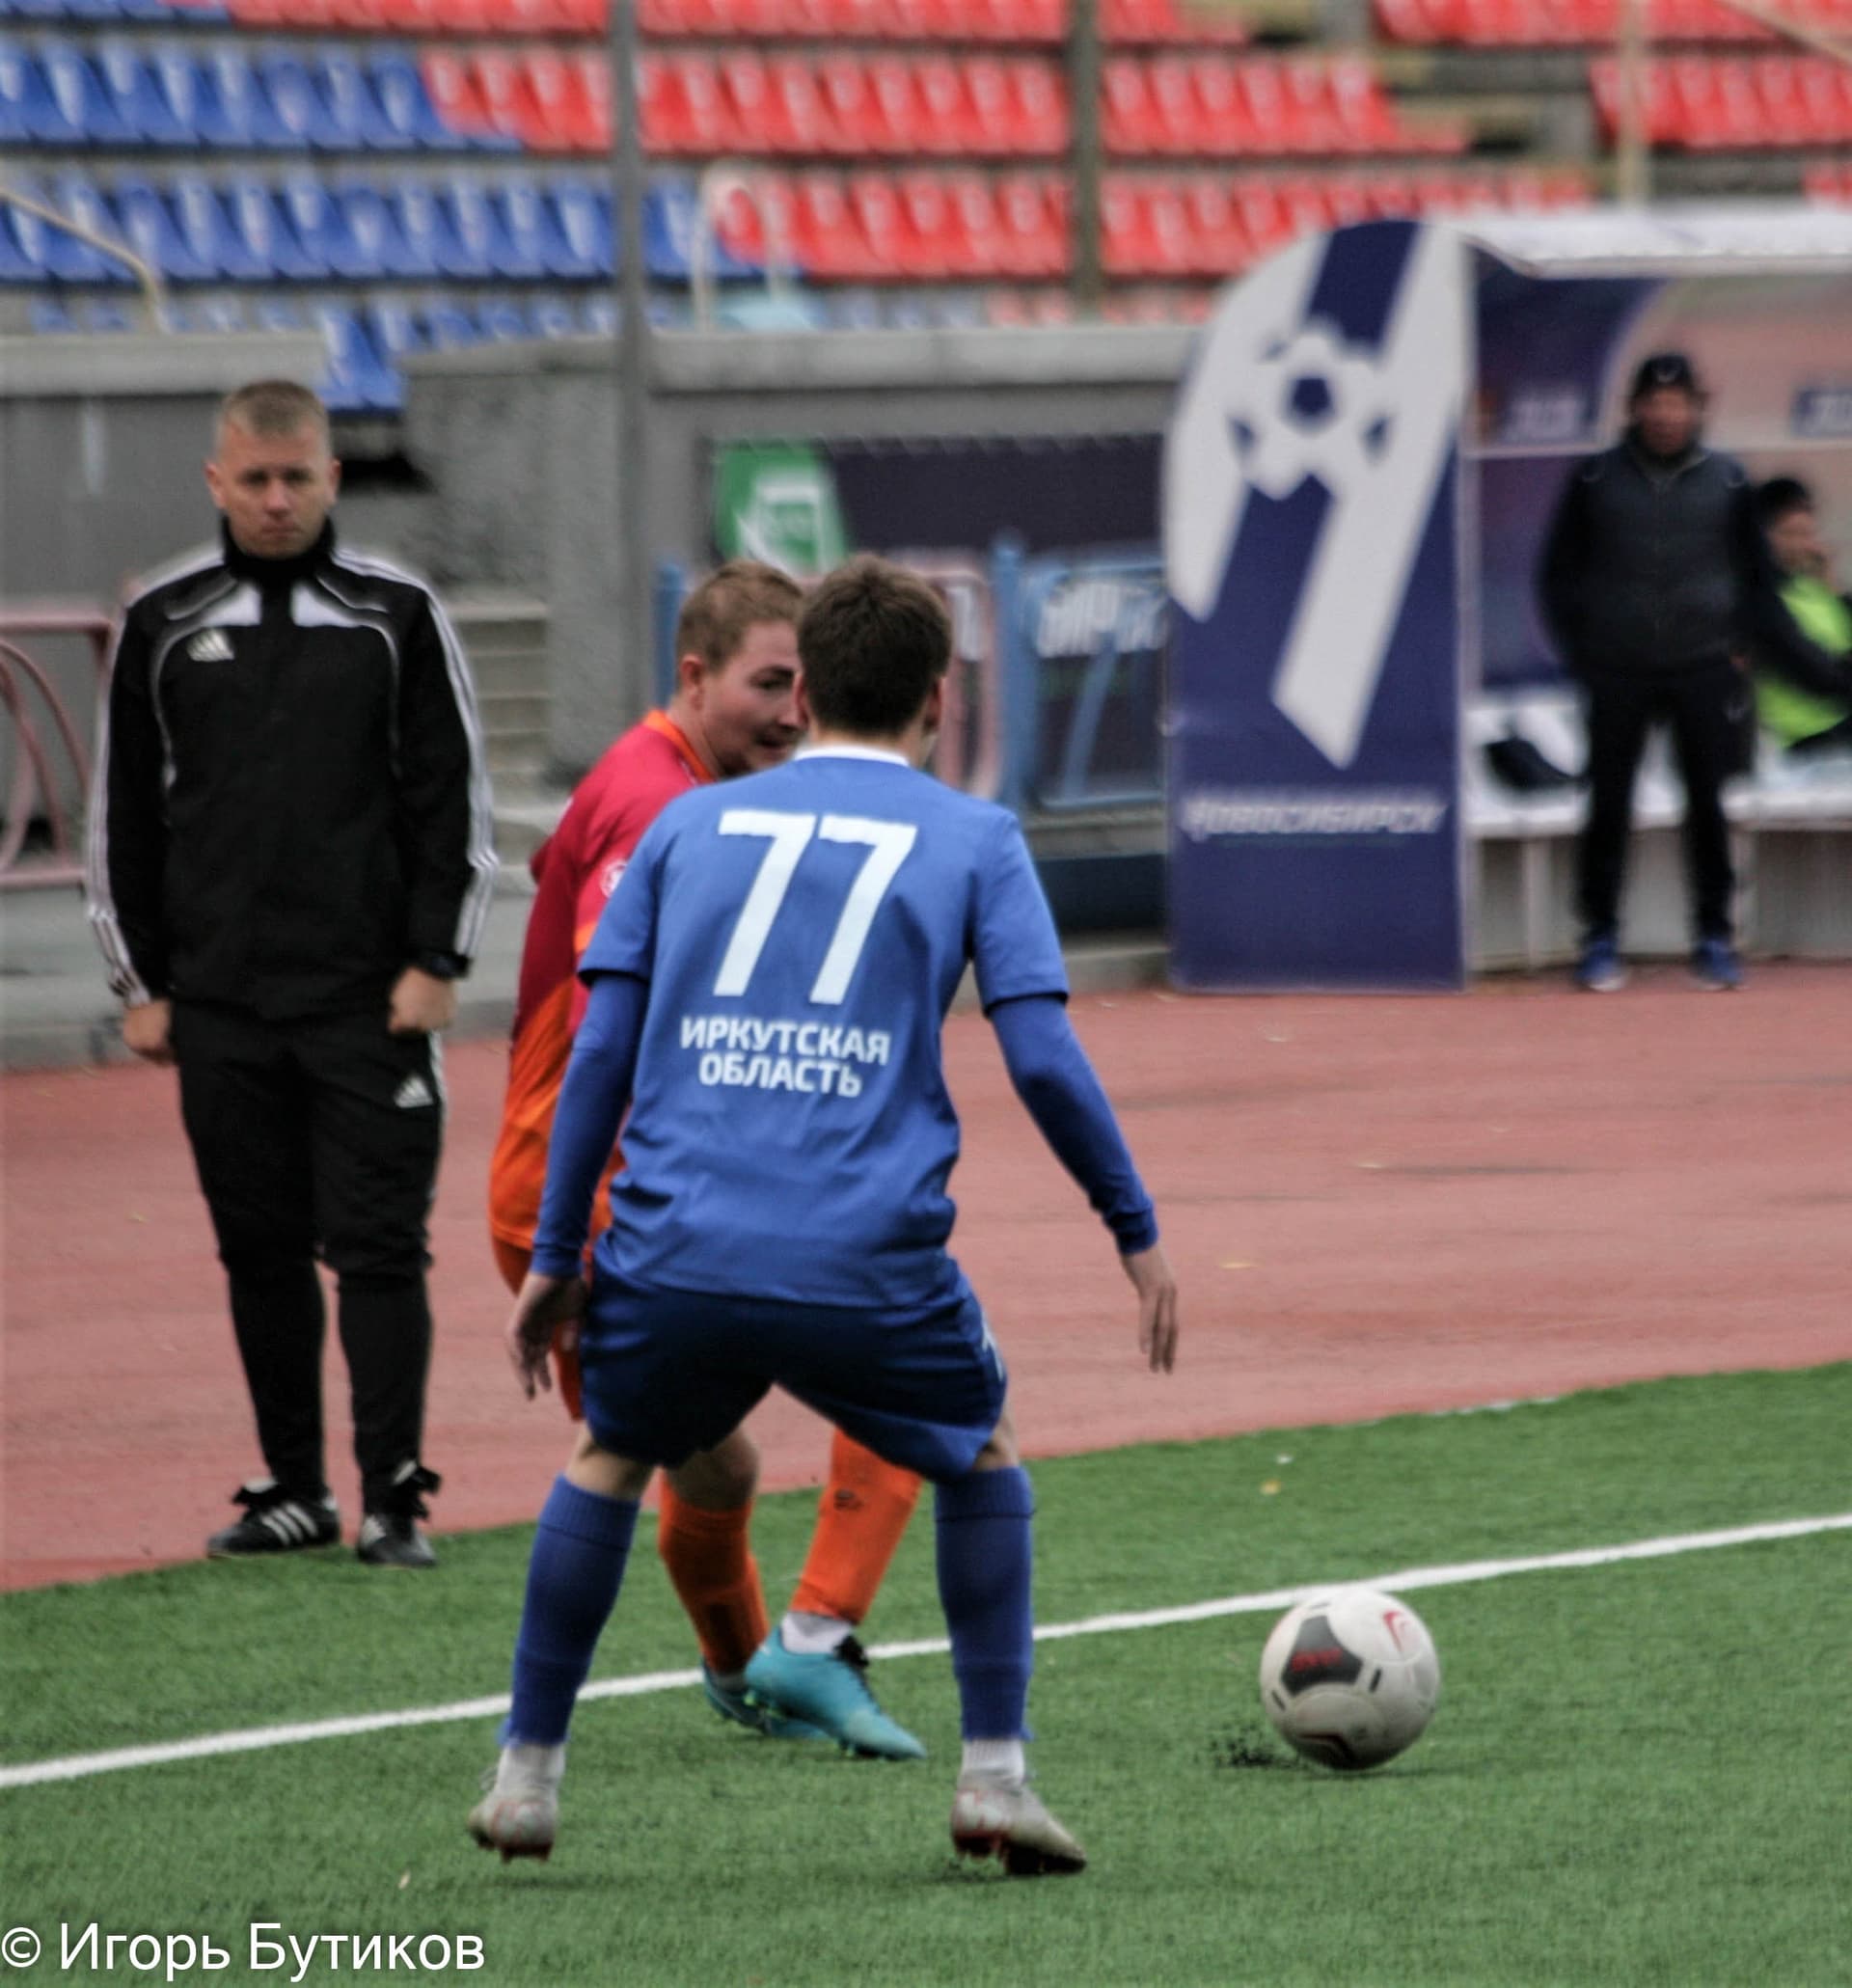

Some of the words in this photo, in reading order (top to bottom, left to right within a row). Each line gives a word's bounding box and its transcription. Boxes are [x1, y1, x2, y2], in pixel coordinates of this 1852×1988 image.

[713, 809, 917, 1005] 77
[679, 1016, 891, 1065] ИРКУТСКАЯ
[698, 1051, 862, 1098] ОБЛАСТЬ
